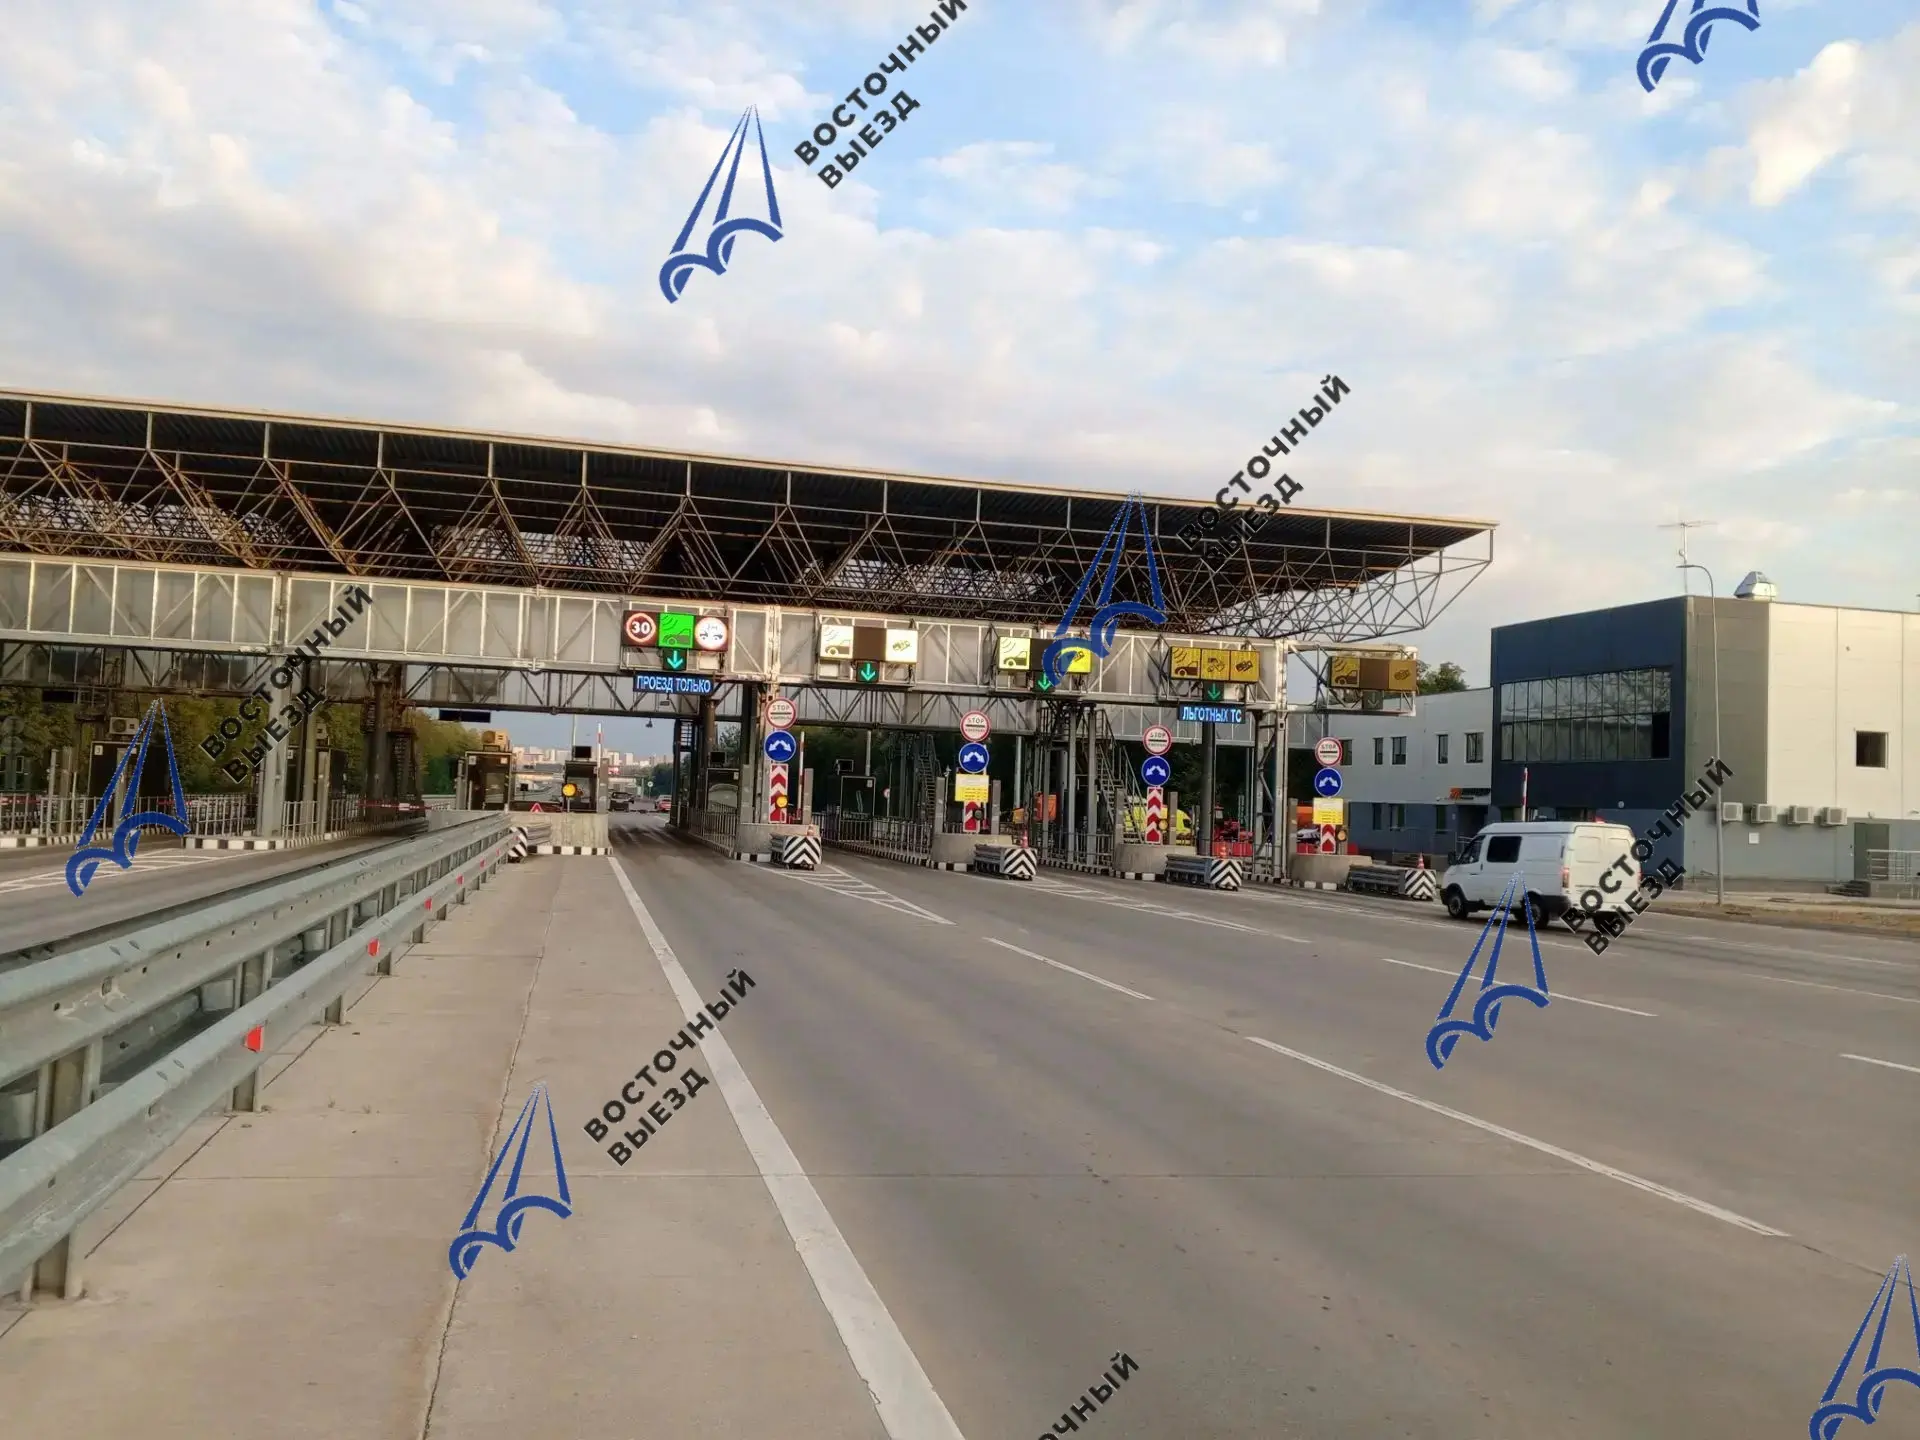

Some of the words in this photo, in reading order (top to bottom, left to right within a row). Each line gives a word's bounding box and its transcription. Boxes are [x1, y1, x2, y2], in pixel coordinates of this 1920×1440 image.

[631, 621, 650, 635] 30
[637, 675, 673, 693] ПРОЕЗД
[675, 678, 711, 693] ТОЛЬКО
[1182, 706, 1228, 722] ЛЬГОТНЫХ
[1230, 709, 1242, 722] ТС
